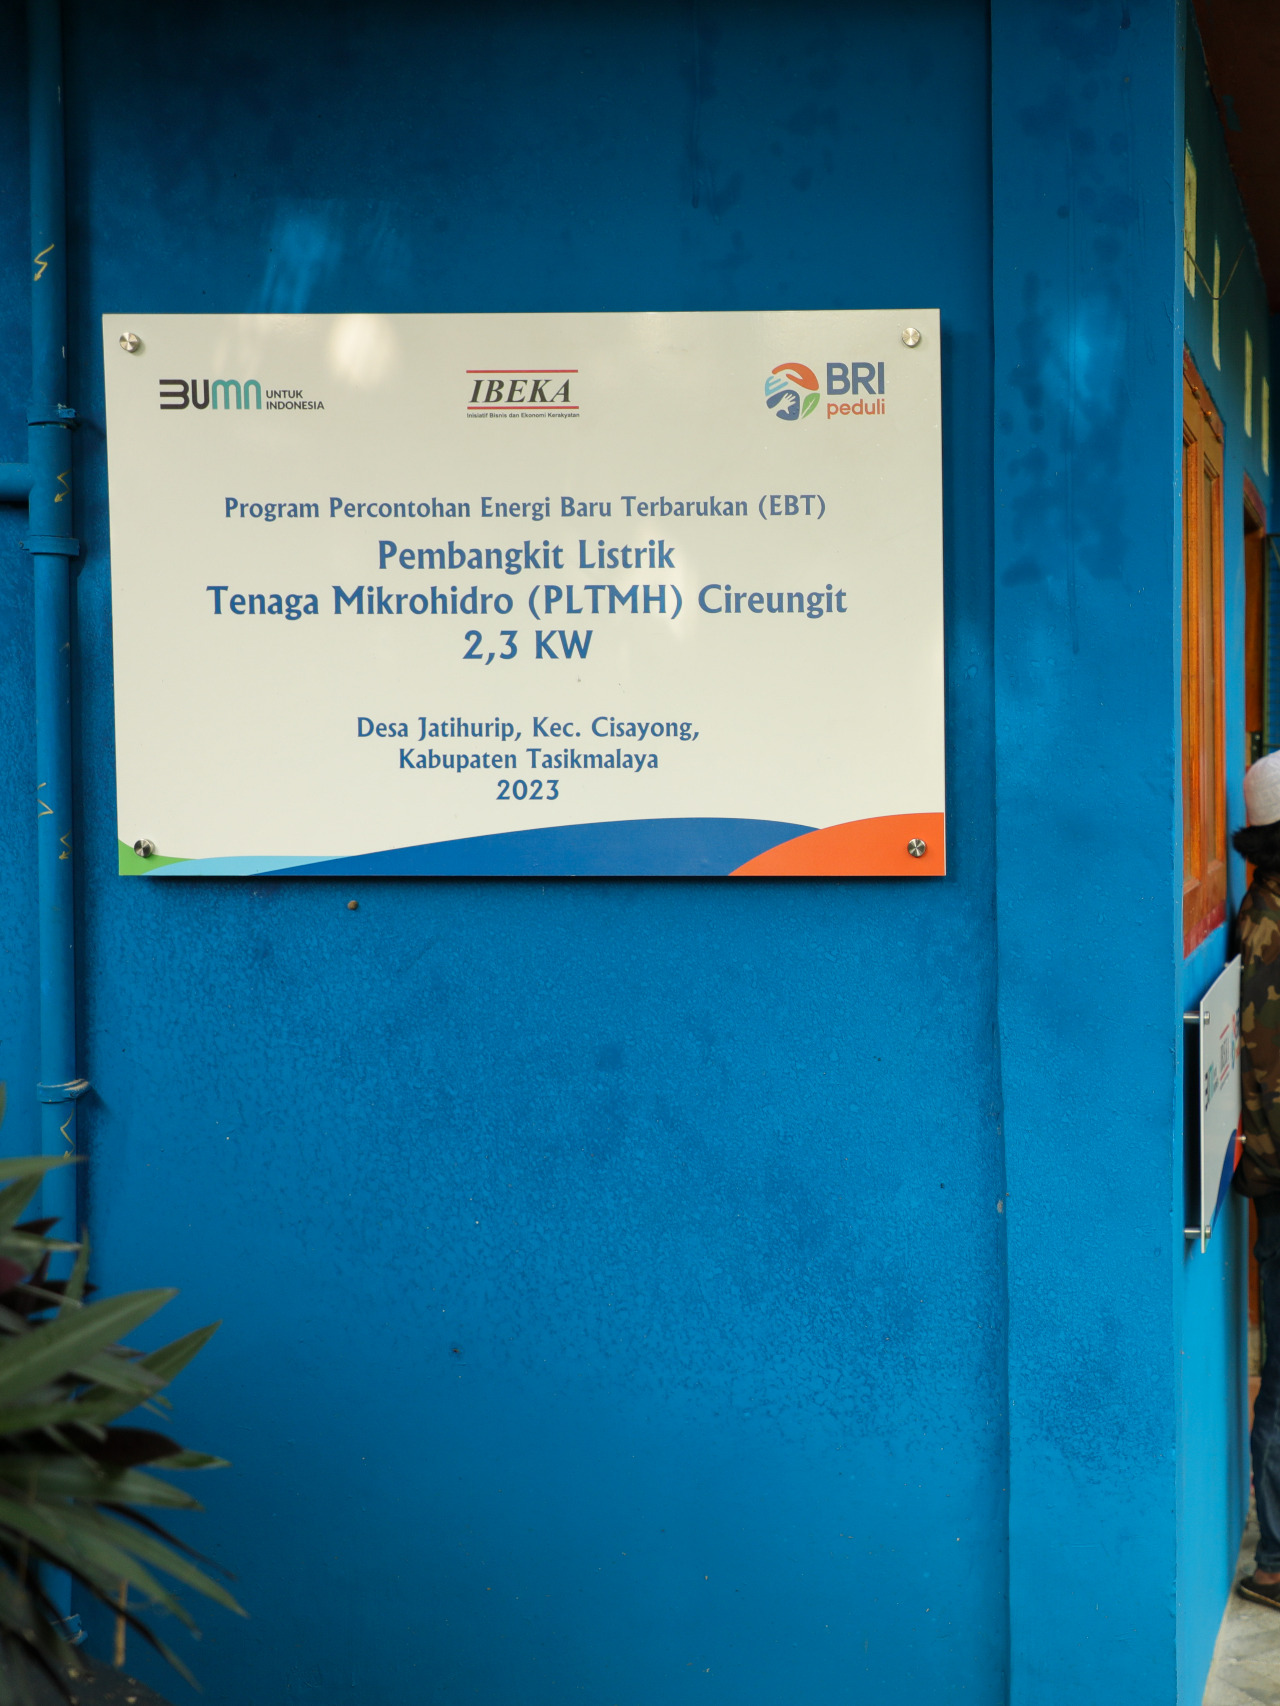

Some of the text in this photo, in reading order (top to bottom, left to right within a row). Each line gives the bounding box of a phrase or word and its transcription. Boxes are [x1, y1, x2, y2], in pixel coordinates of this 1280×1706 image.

[469, 379, 571, 403] IBEKA
[826, 361, 885, 396] BRI
[266, 389, 304, 399] UNTUK
[266, 401, 325, 410] INDONESIA
[826, 398, 886, 420] peduli
[224, 495, 827, 522] Program Percontohan Energi Baru Terbarukan (EBT)
[378, 540, 676, 574] Pembangkit Listrik
[206, 584, 848, 620] Tenaga Mikrohidro (PLTMH) Cireungit
[463, 630, 594, 666] 2,3 KW
[357, 716, 701, 742] Desa Jatihurip, Kec. Cisayong,
[399, 748, 659, 773] Kabupaten Tasikmalaya
[495, 779, 560, 801] 2023
